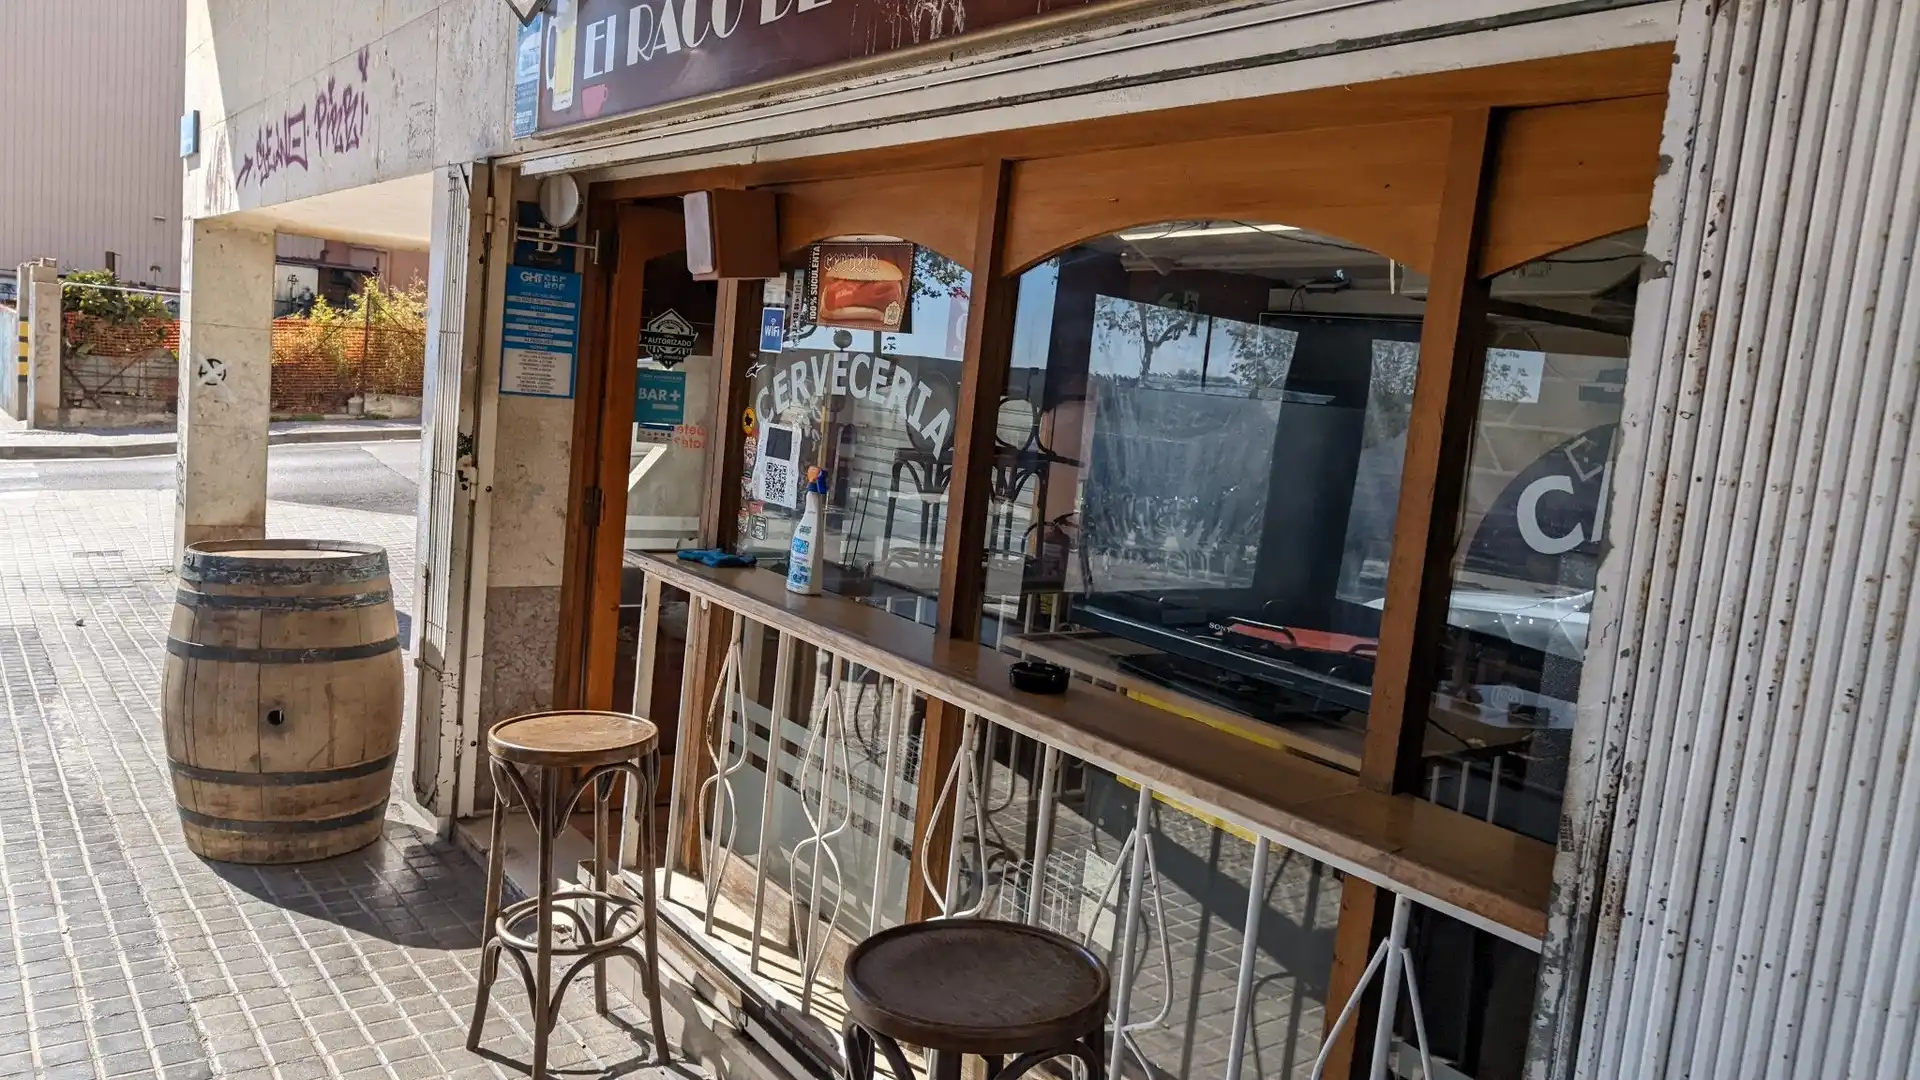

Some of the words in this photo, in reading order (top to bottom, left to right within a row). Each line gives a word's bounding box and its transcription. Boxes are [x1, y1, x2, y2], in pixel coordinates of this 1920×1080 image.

[810, 246, 821, 295] SUCULENTA
[647, 336, 692, 348] AUTORIZADO
[755, 351, 952, 461] CERVECERIA
